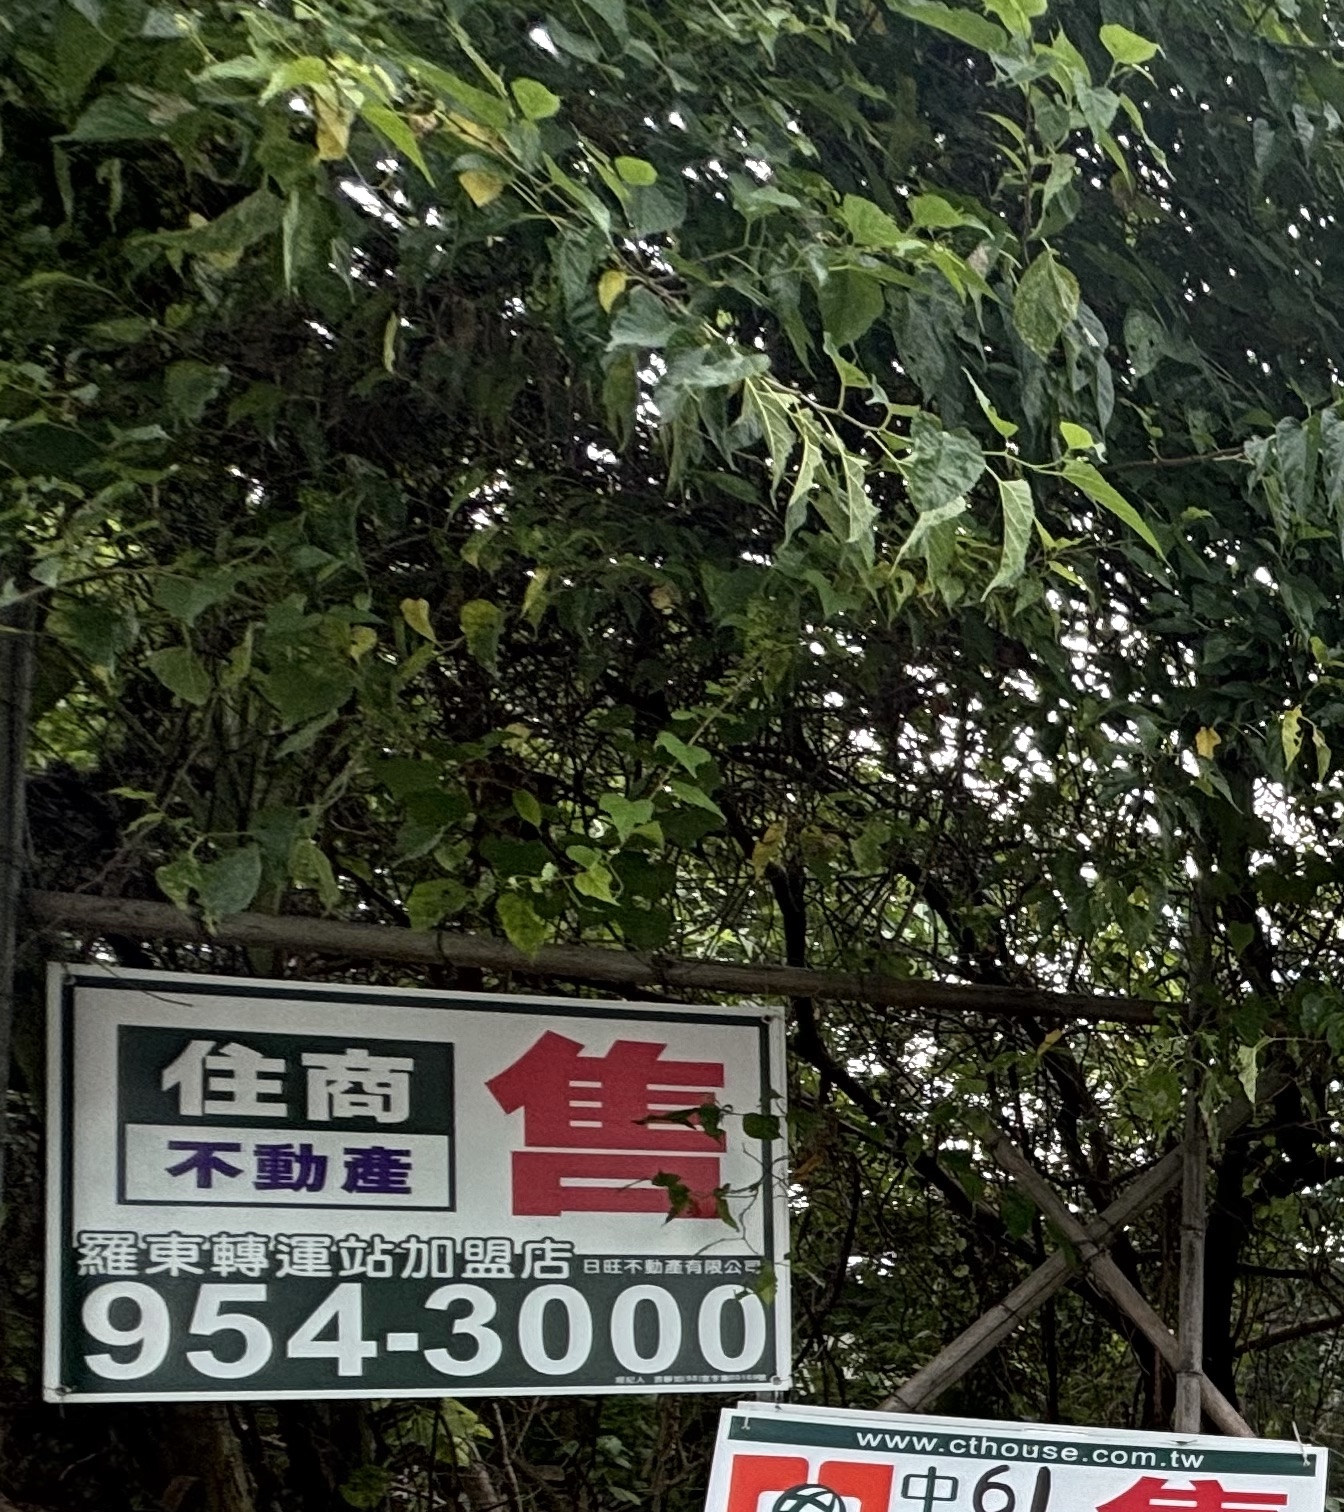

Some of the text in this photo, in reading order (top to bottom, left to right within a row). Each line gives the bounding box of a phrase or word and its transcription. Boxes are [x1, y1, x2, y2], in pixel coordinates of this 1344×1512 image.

[162, 1039, 413, 1124] 住商
[485, 1030, 727, 1219] 售
[166, 1140, 412, 1194] 不動產
[78, 1231, 573, 1279] 羅東轉運站加盟店
[583, 1258, 762, 1275] 日旺不動產有限公司
[82, 1281, 766, 1380] 954-3000
[857, 1430, 1204, 1469] www.cthouse.com.tw
